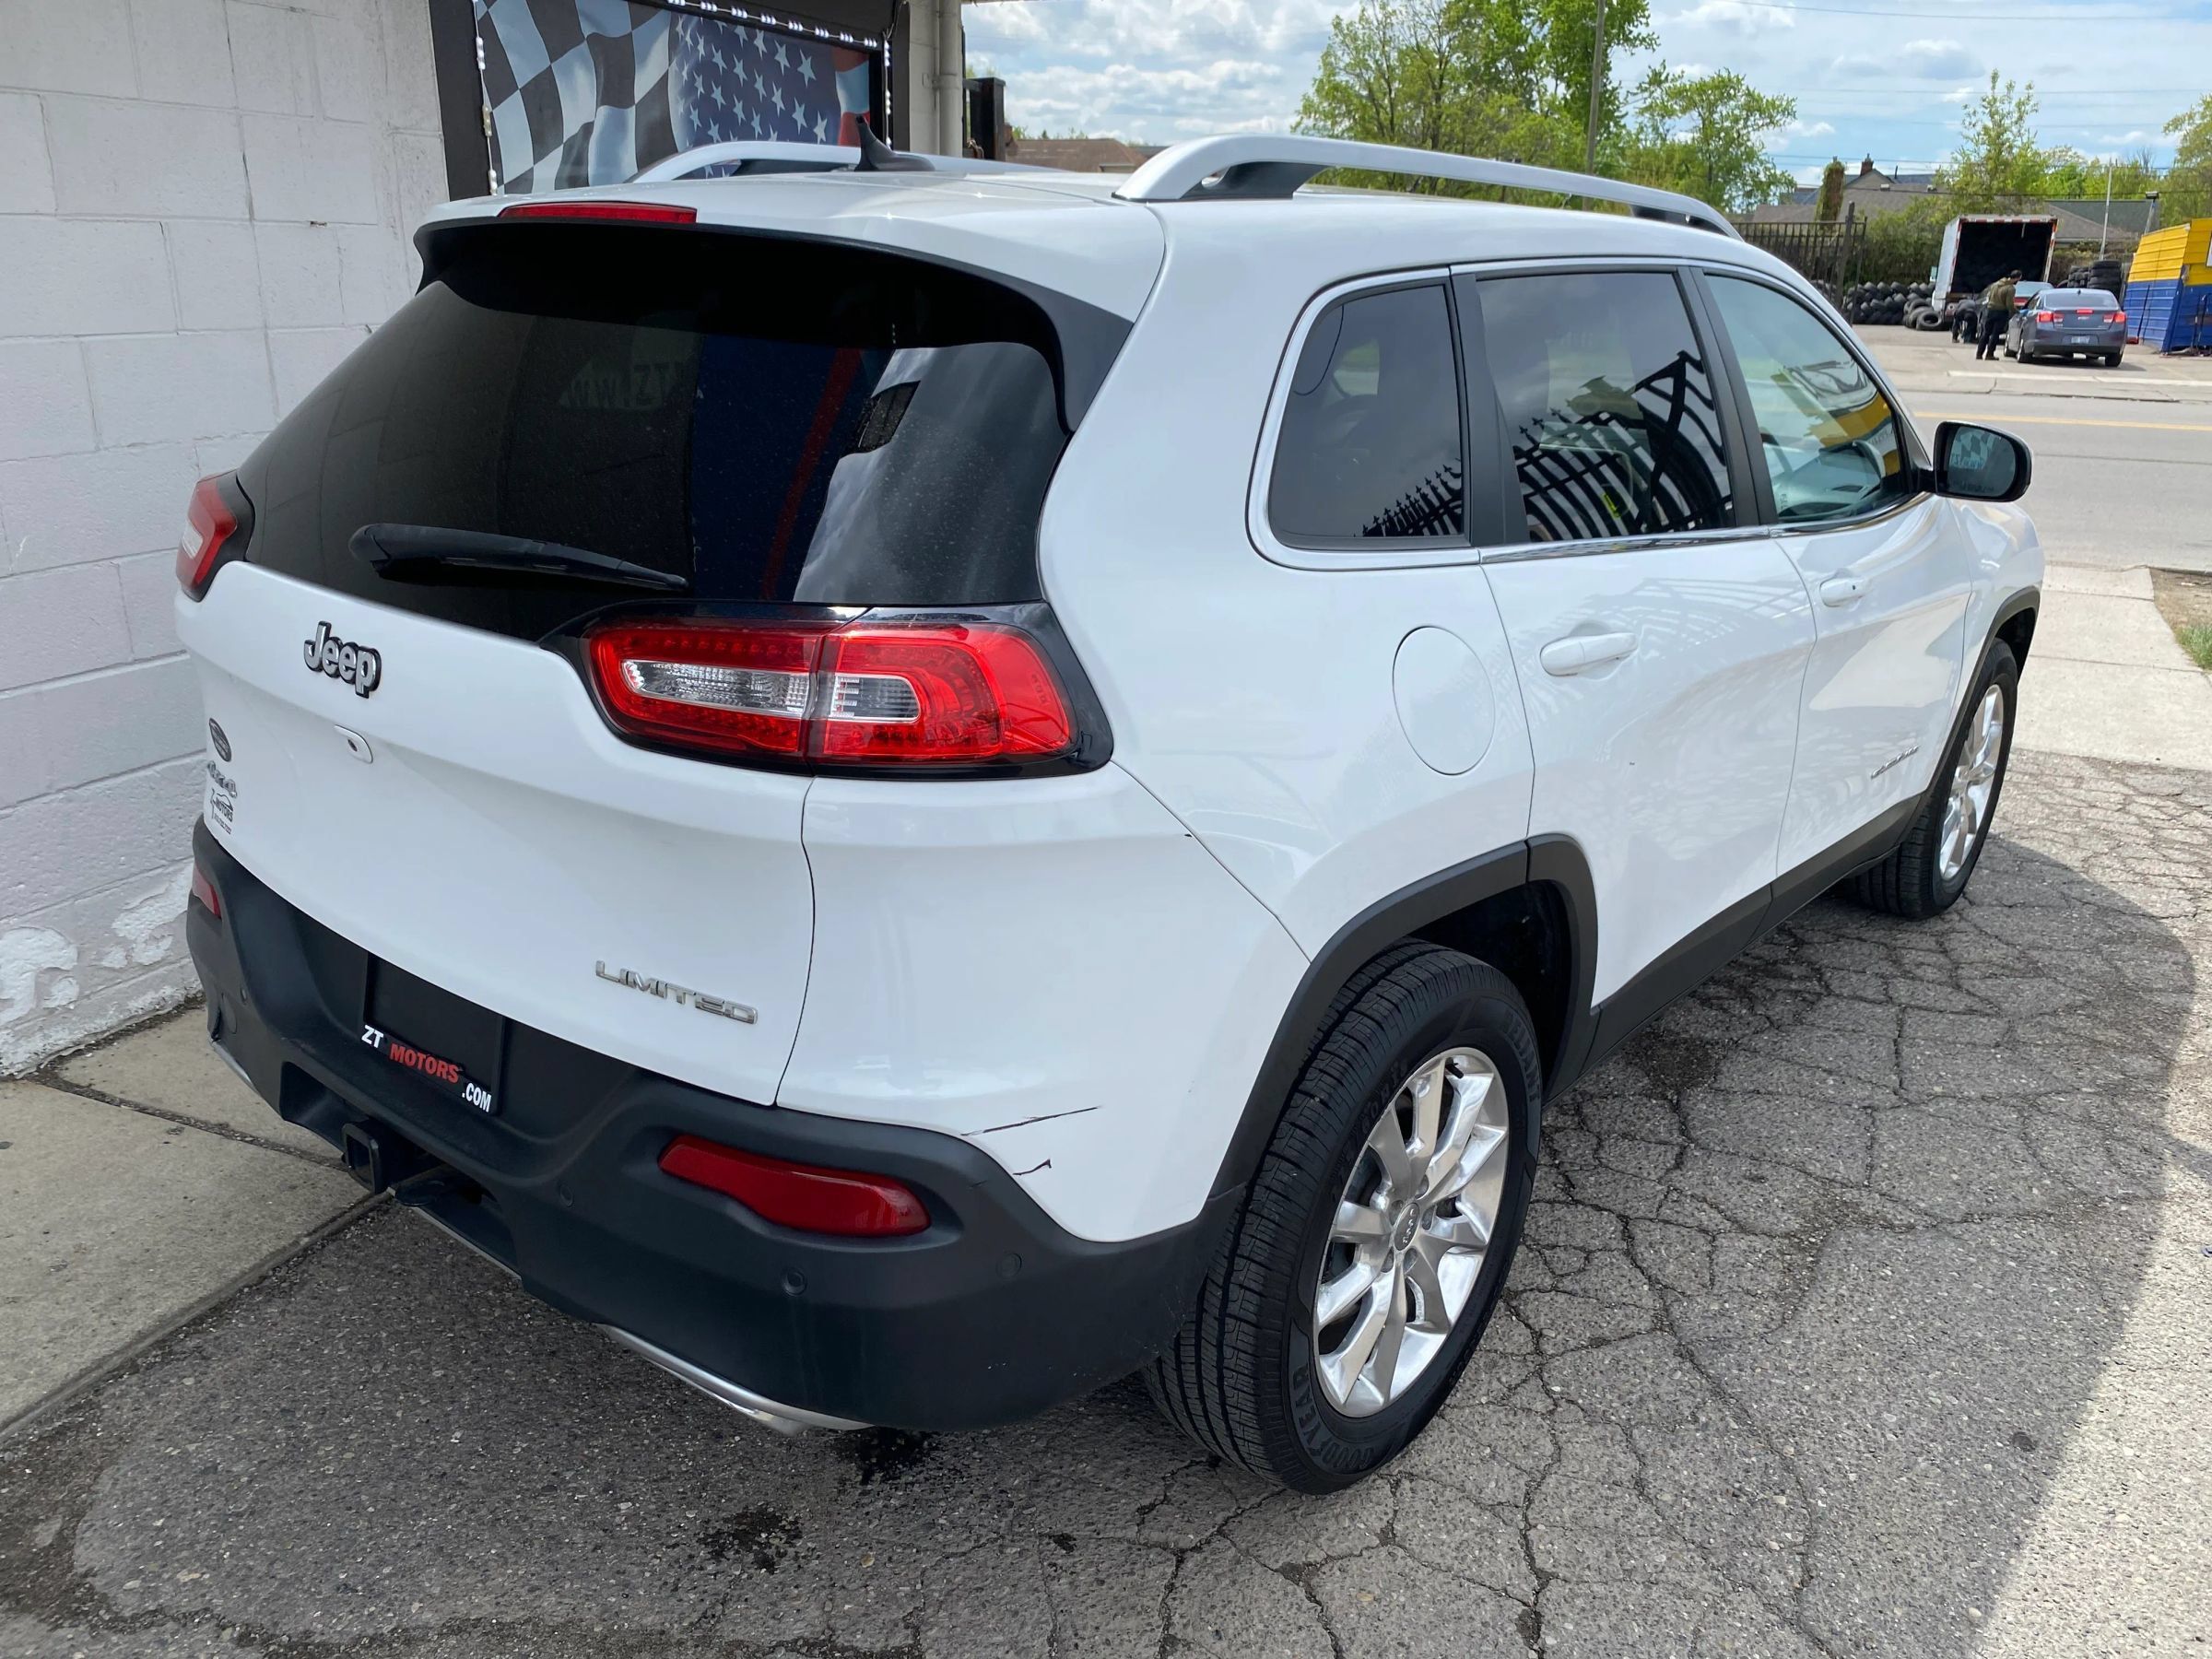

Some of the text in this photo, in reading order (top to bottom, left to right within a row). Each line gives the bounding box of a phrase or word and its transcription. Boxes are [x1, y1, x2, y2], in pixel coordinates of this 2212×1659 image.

[303, 620, 382, 699] Jeep
[595, 959, 759, 1025] LIMITED
[360, 1024, 492, 1113] ZT MOTORS .COM
